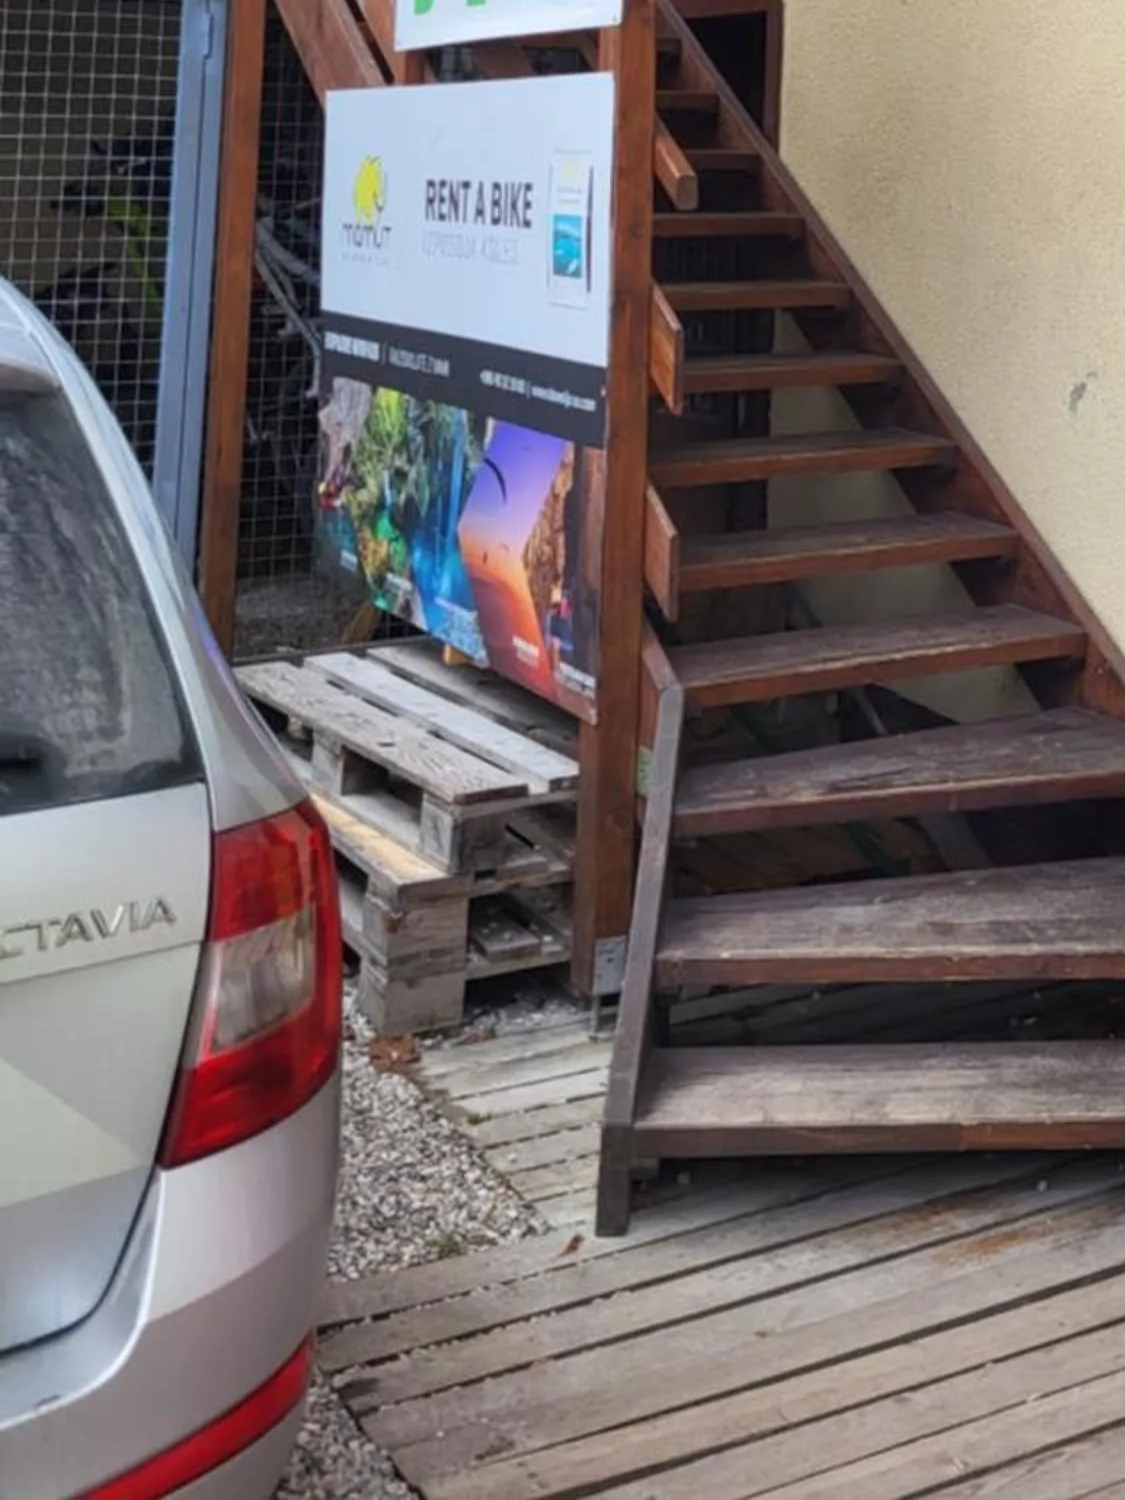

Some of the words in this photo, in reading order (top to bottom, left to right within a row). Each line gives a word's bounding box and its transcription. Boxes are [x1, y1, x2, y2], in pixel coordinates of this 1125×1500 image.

[425, 178, 471, 223] RENT
[474, 179, 485, 226] A
[490, 181, 533, 229] BIKE
